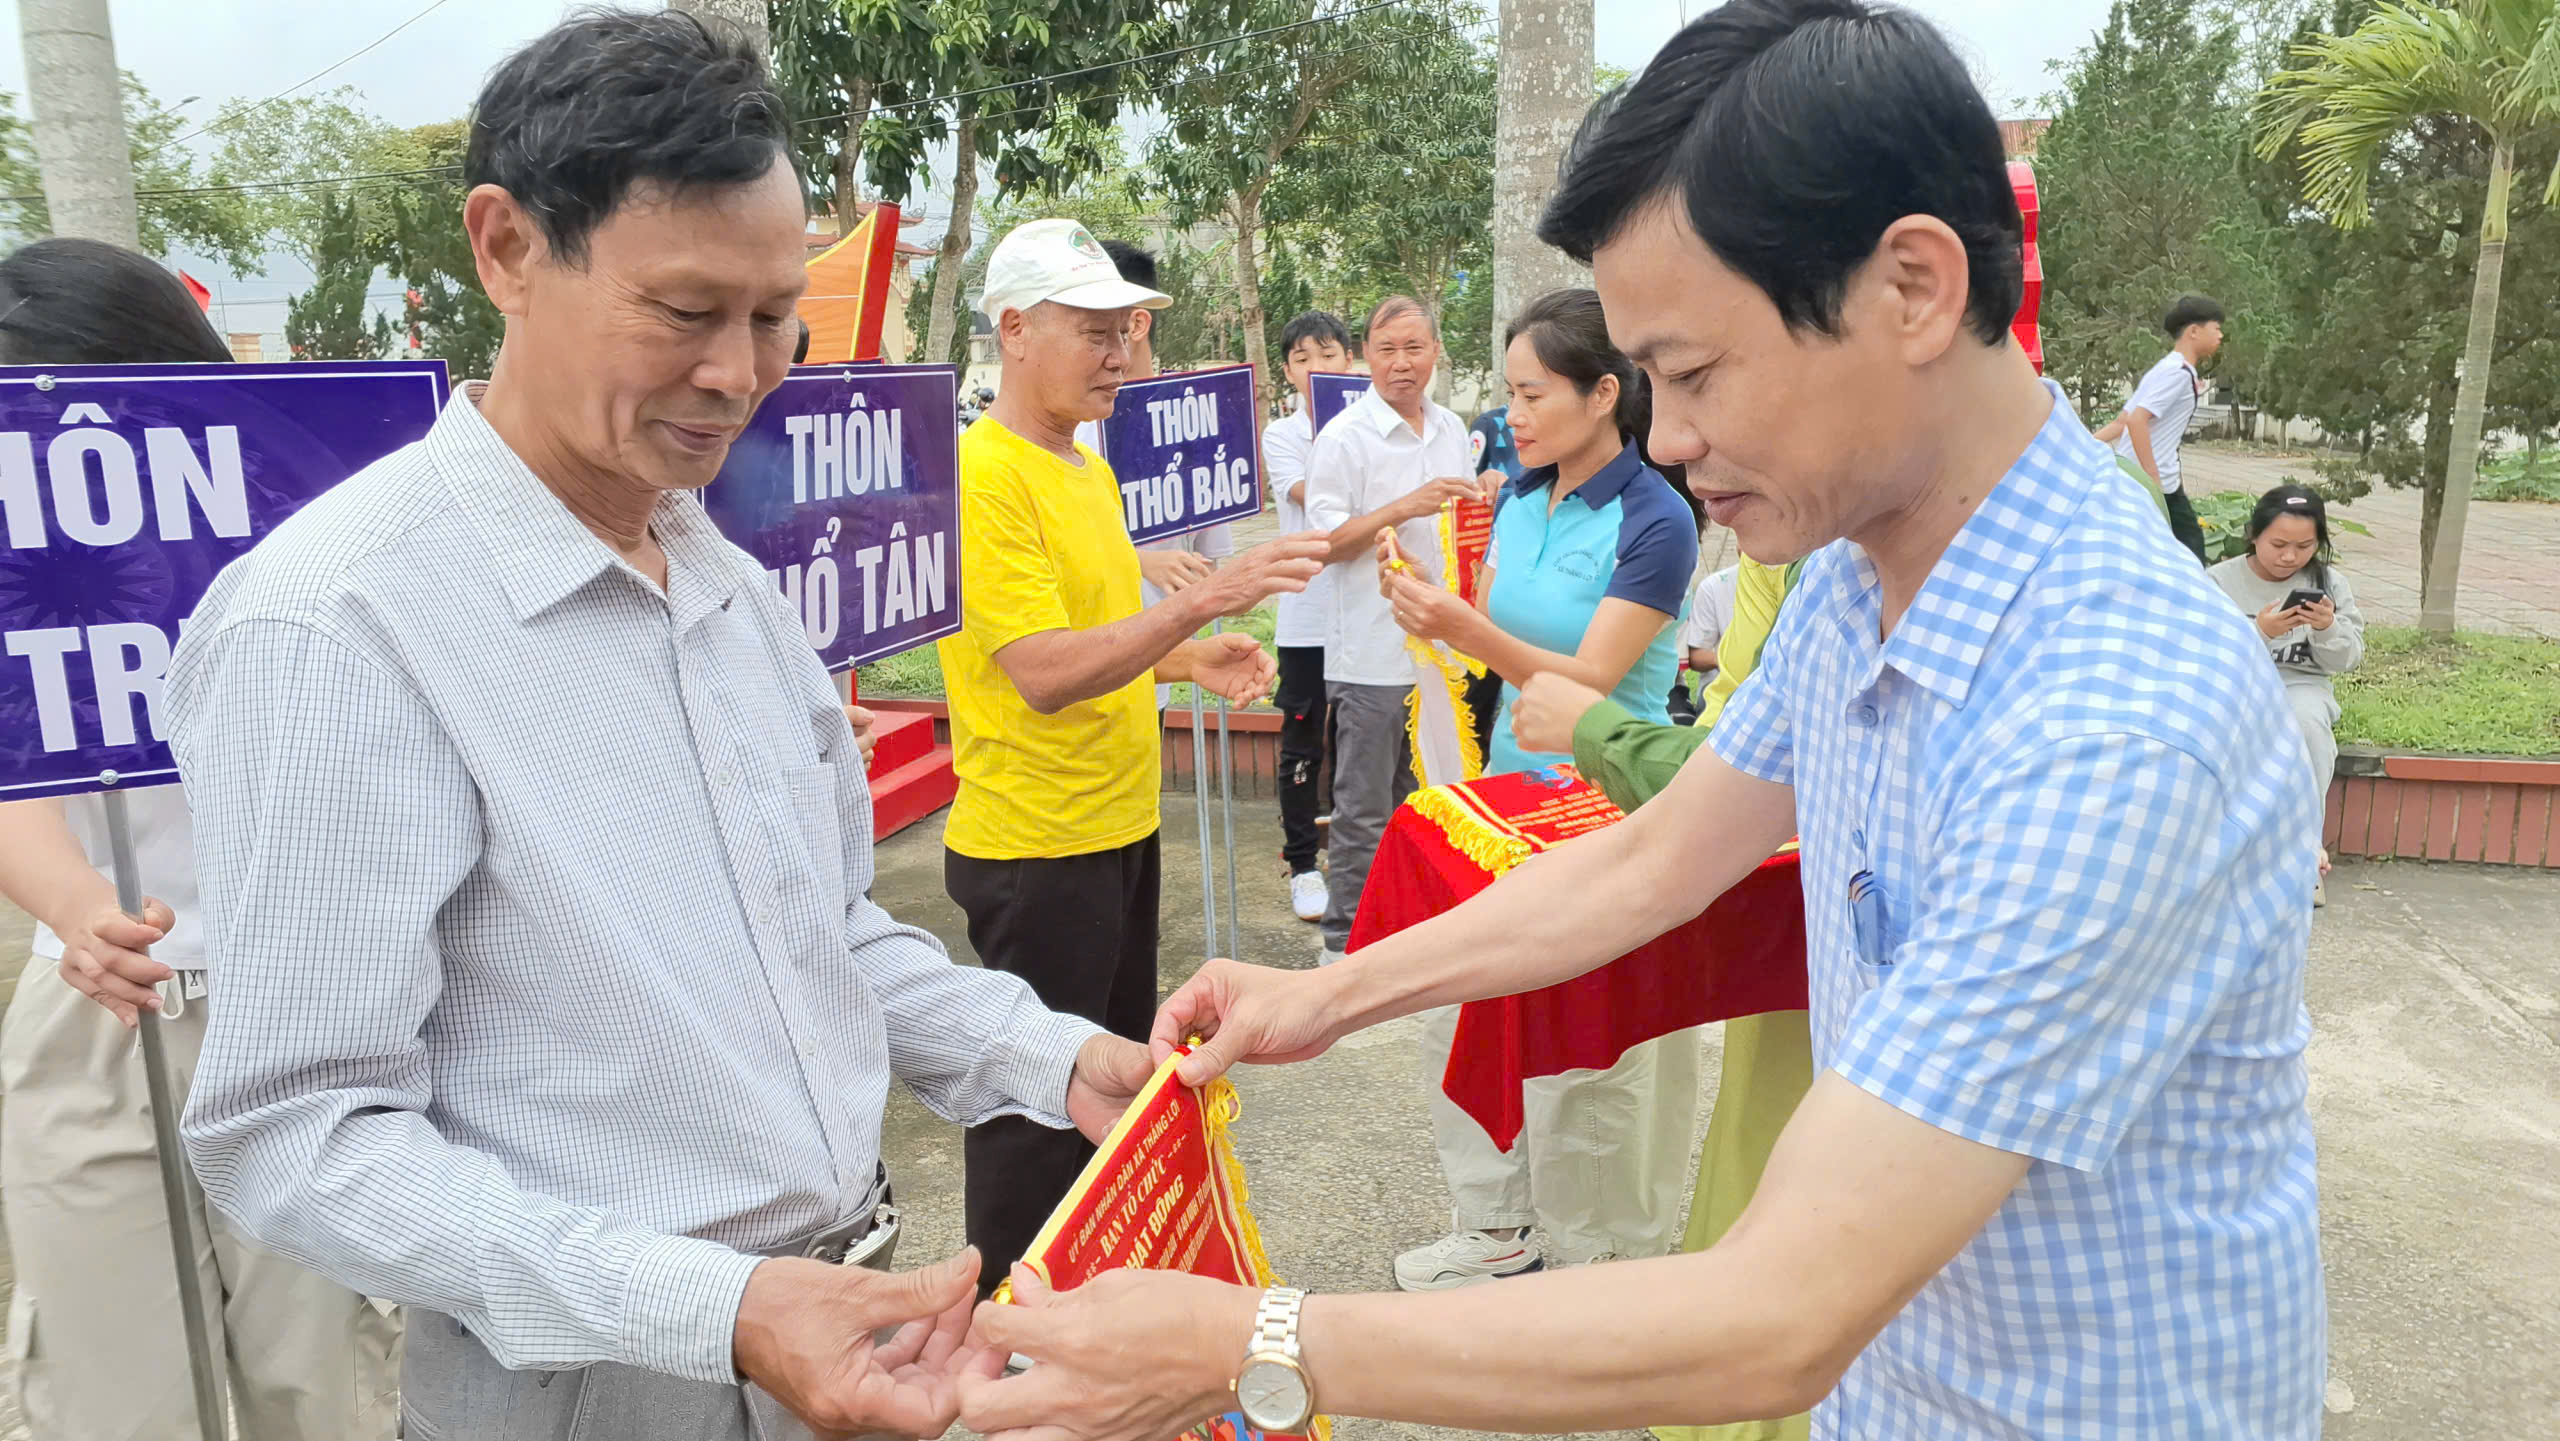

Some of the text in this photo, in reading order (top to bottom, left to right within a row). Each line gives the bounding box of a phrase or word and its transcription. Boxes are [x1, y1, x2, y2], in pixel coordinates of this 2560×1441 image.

[786, 392, 902, 504] THÔN
[1147, 386, 1219, 447] THÔN
[1121, 444, 1250, 532] THỔ BẮC
[855, 521, 945, 635] TÂN
[4, 619, 190, 752] TR
[1080, 1213, 1096, 1247] BAN
[1095, 1182, 1118, 1222] NHÂN
[1117, 1160, 1134, 1191] DÂN
[1101, 1154, 1166, 1258] BAN TỔ CHỨC
[1123, 1226, 1153, 1269] HÁT
[1148, 1173, 1184, 1238] ĐỘNG
